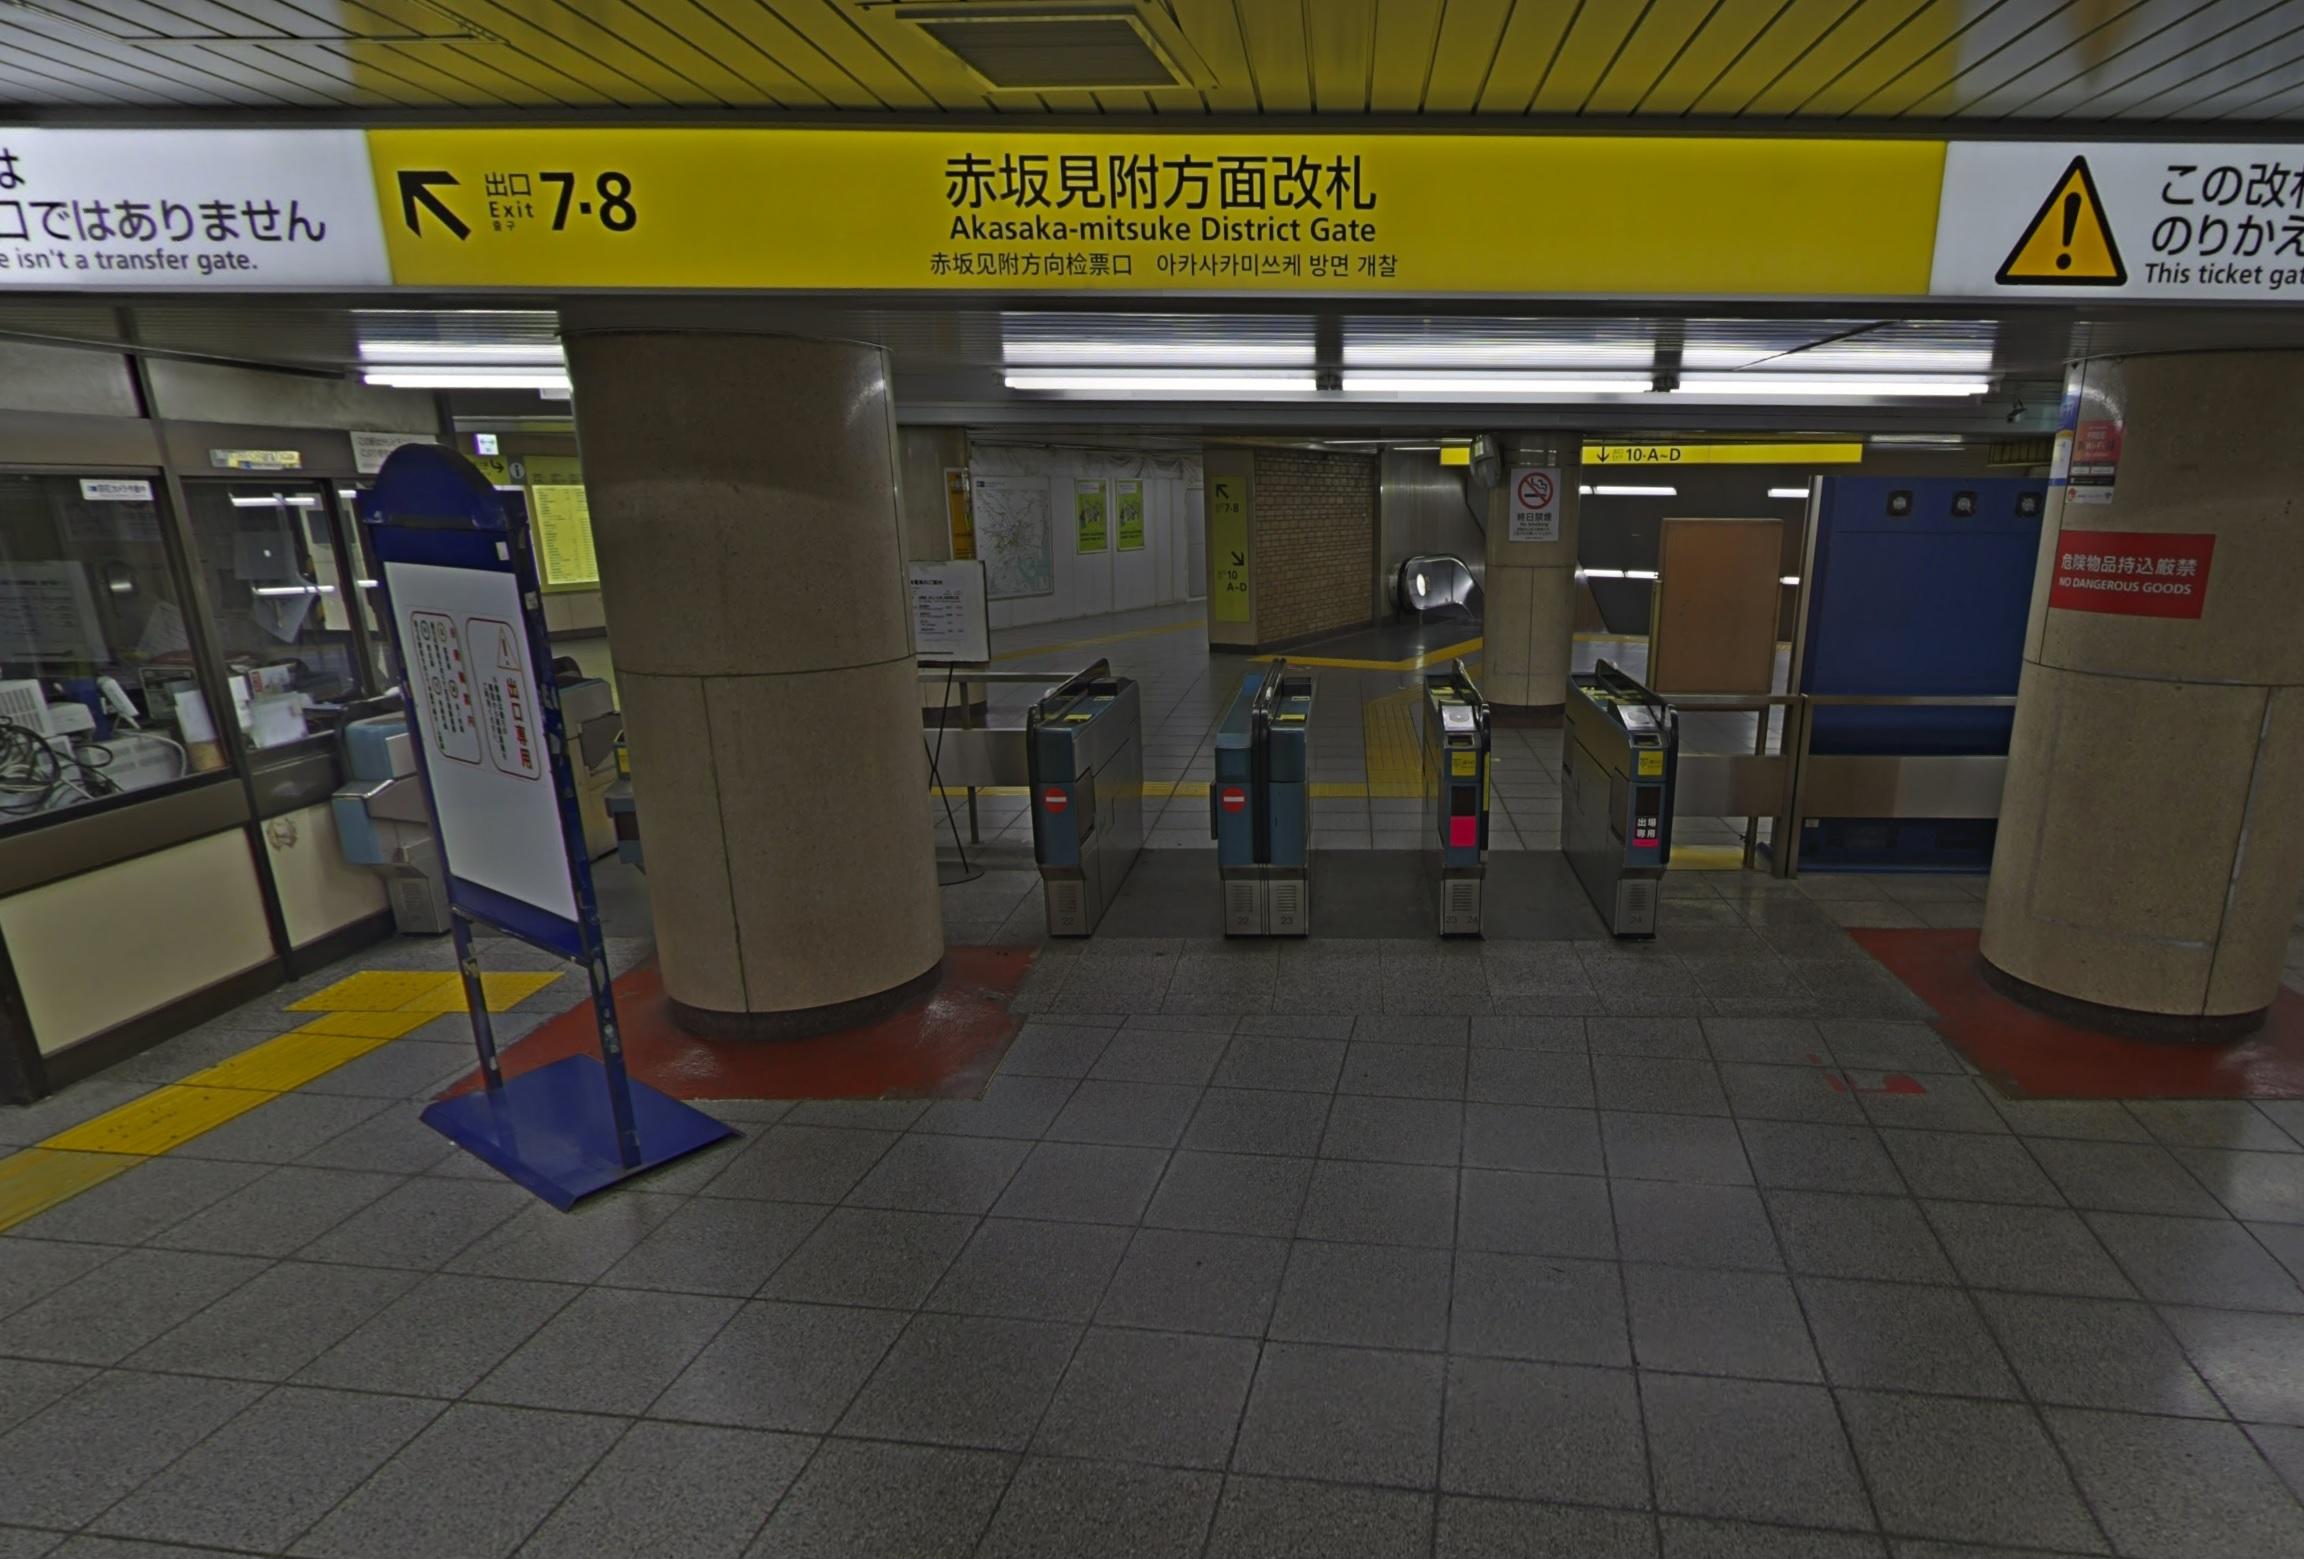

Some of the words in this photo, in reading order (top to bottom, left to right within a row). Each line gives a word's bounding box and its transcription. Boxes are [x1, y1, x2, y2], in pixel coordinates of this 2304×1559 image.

[486, 172, 532, 197] 出口
[945, 153, 1376, 210] 赤坂見附方面改札
[0, 199, 326, 242] 口ではありません
[488, 201, 534, 218] Exit
[950, 215, 1191, 241] Akasaka-mitsuke
[1201, 215, 1300, 242] District
[1310, 217, 1376, 242] Gate
[15, 247, 69, 269] isn't
[76, 253, 89, 269] a
[95, 248, 188, 270] transfer
[197, 251, 258, 275] gate.
[929, 252, 1133, 277] 赤坂见附方向检票口
[1156, 254, 1301, 277] 아카사카미쓰케
[1309, 254, 1350, 277] 방면
[1357, 254, 1398, 278] 개찰
[2145, 262, 2191, 285] This
[2198, 262, 2263, 285] ticket
[2061, 553, 2198, 577] 危険物品持込厳禁
[2058, 577, 2071, 587] NO
[2072, 578, 2139, 593] DANGEROUS
[2142, 581, 2192, 595] GOODS
